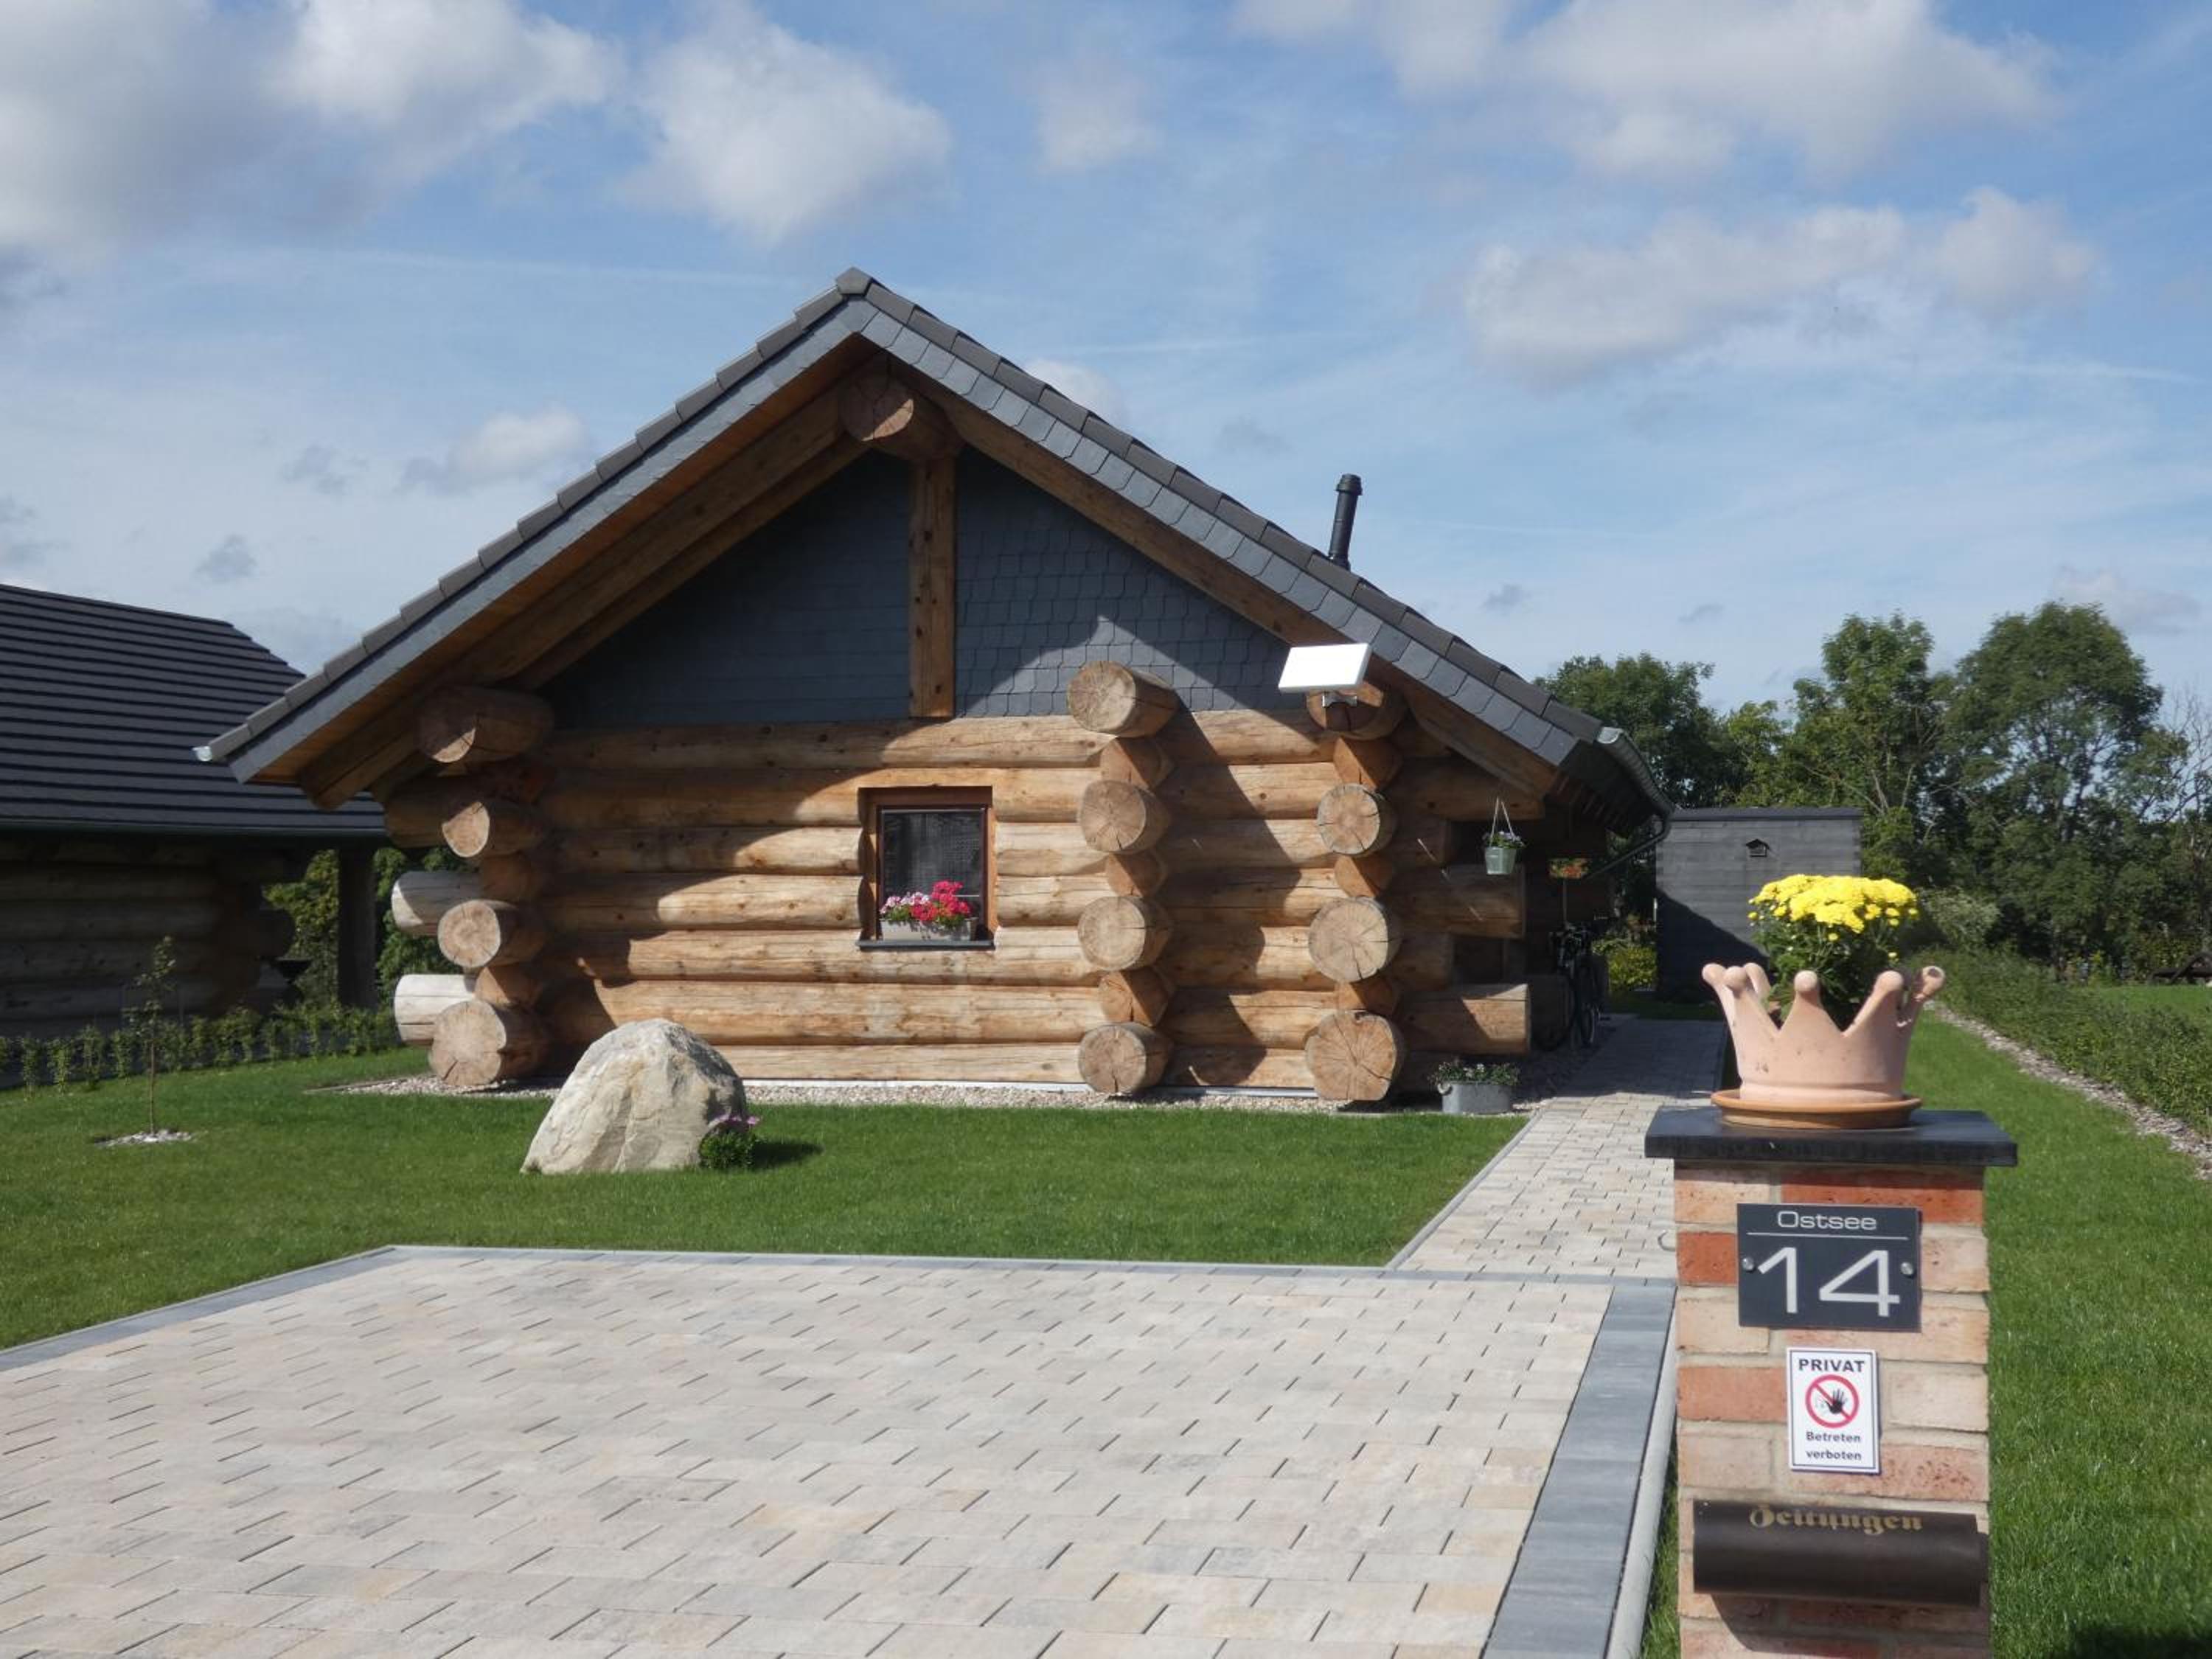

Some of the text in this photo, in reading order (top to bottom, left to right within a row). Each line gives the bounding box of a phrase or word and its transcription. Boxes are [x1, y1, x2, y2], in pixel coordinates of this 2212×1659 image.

[1778, 1211, 1877, 1230] Ostsee
[1758, 1247, 1900, 1317] 14
[1798, 1359, 1865, 1372] PRIVAT
[1806, 1431, 1861, 1443] Betreten
[1806, 1450, 1862, 1461] verboten
